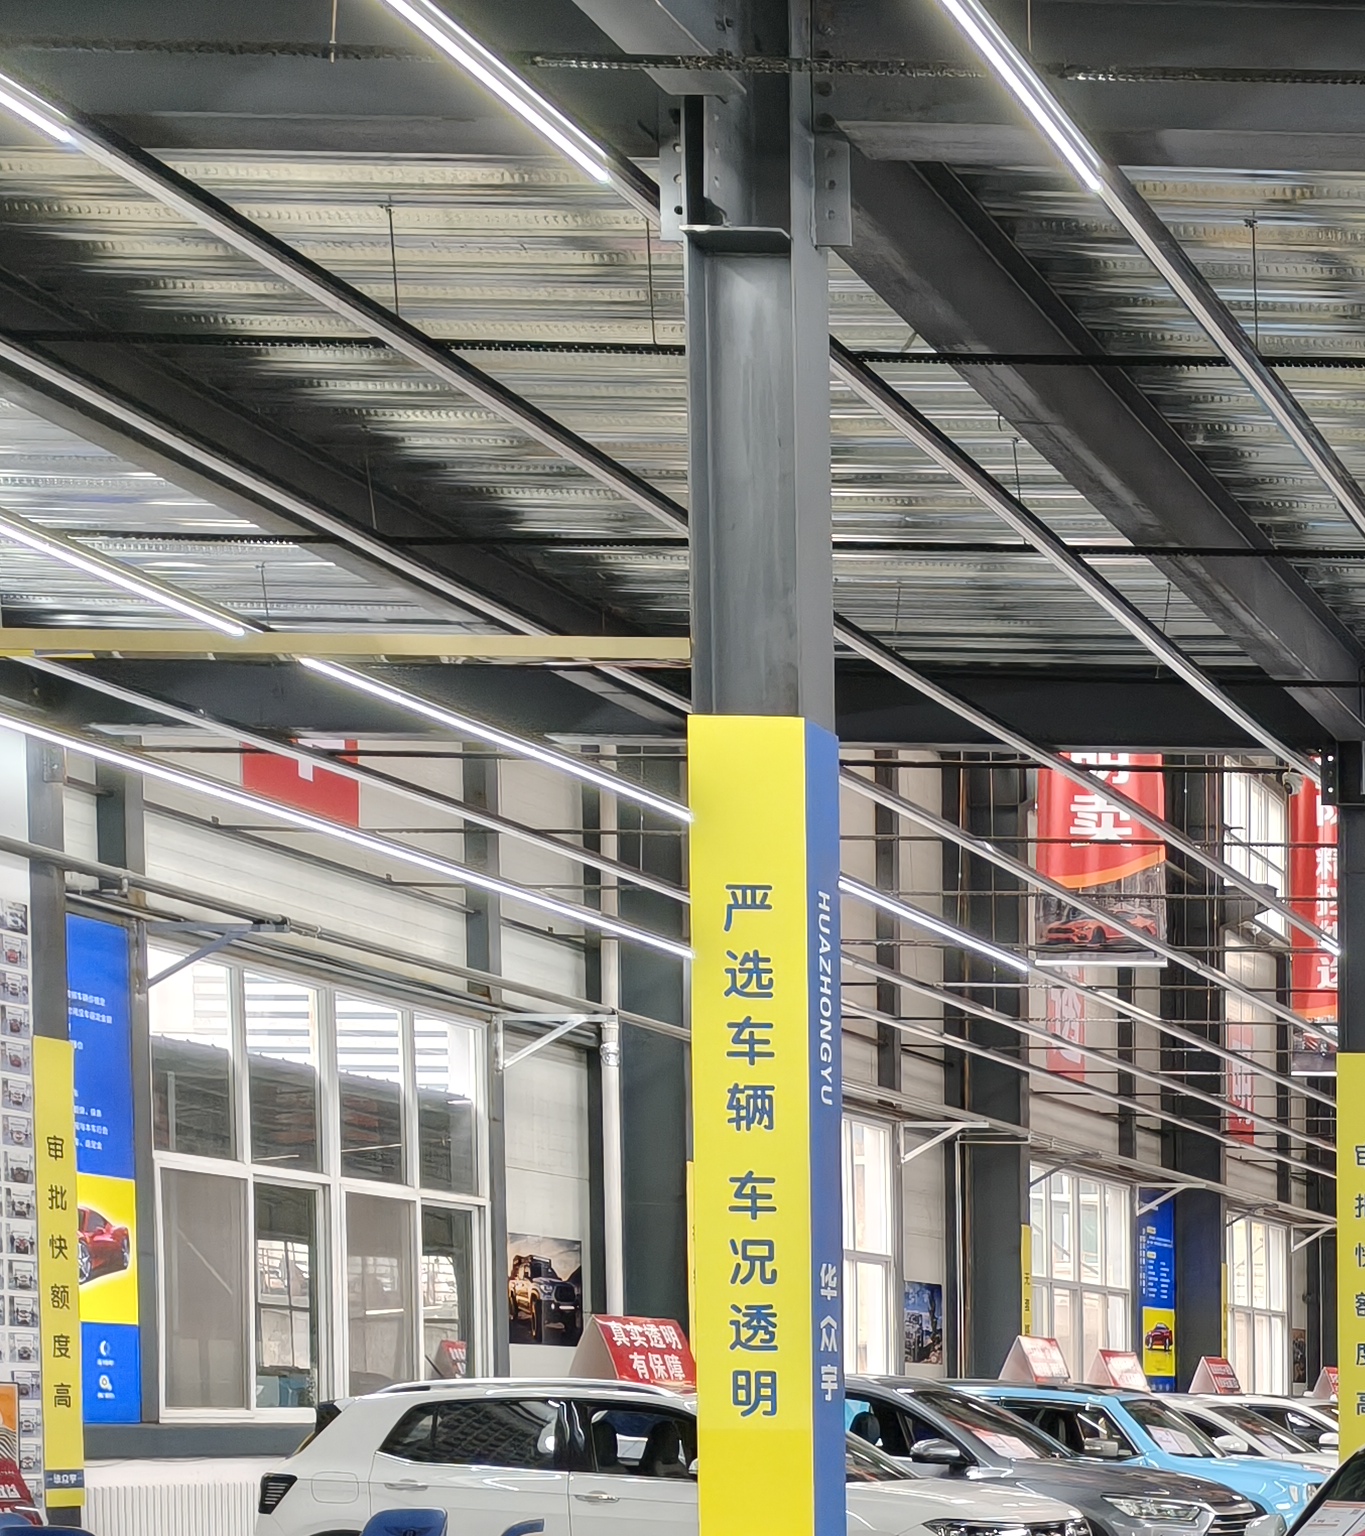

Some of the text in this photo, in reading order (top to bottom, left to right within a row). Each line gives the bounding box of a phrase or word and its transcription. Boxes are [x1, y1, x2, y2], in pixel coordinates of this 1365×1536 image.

[818, 890, 833, 1106] HUAZHONGYU
[723, 883, 779, 1418] 严选车辆 车况透明
[46, 1136, 72, 1409] 审批快额度高
[609, 1320, 684, 1351] 真实透明
[820, 1262, 839, 1403] 华众宇
[629, 1352, 686, 1381] 有保障
